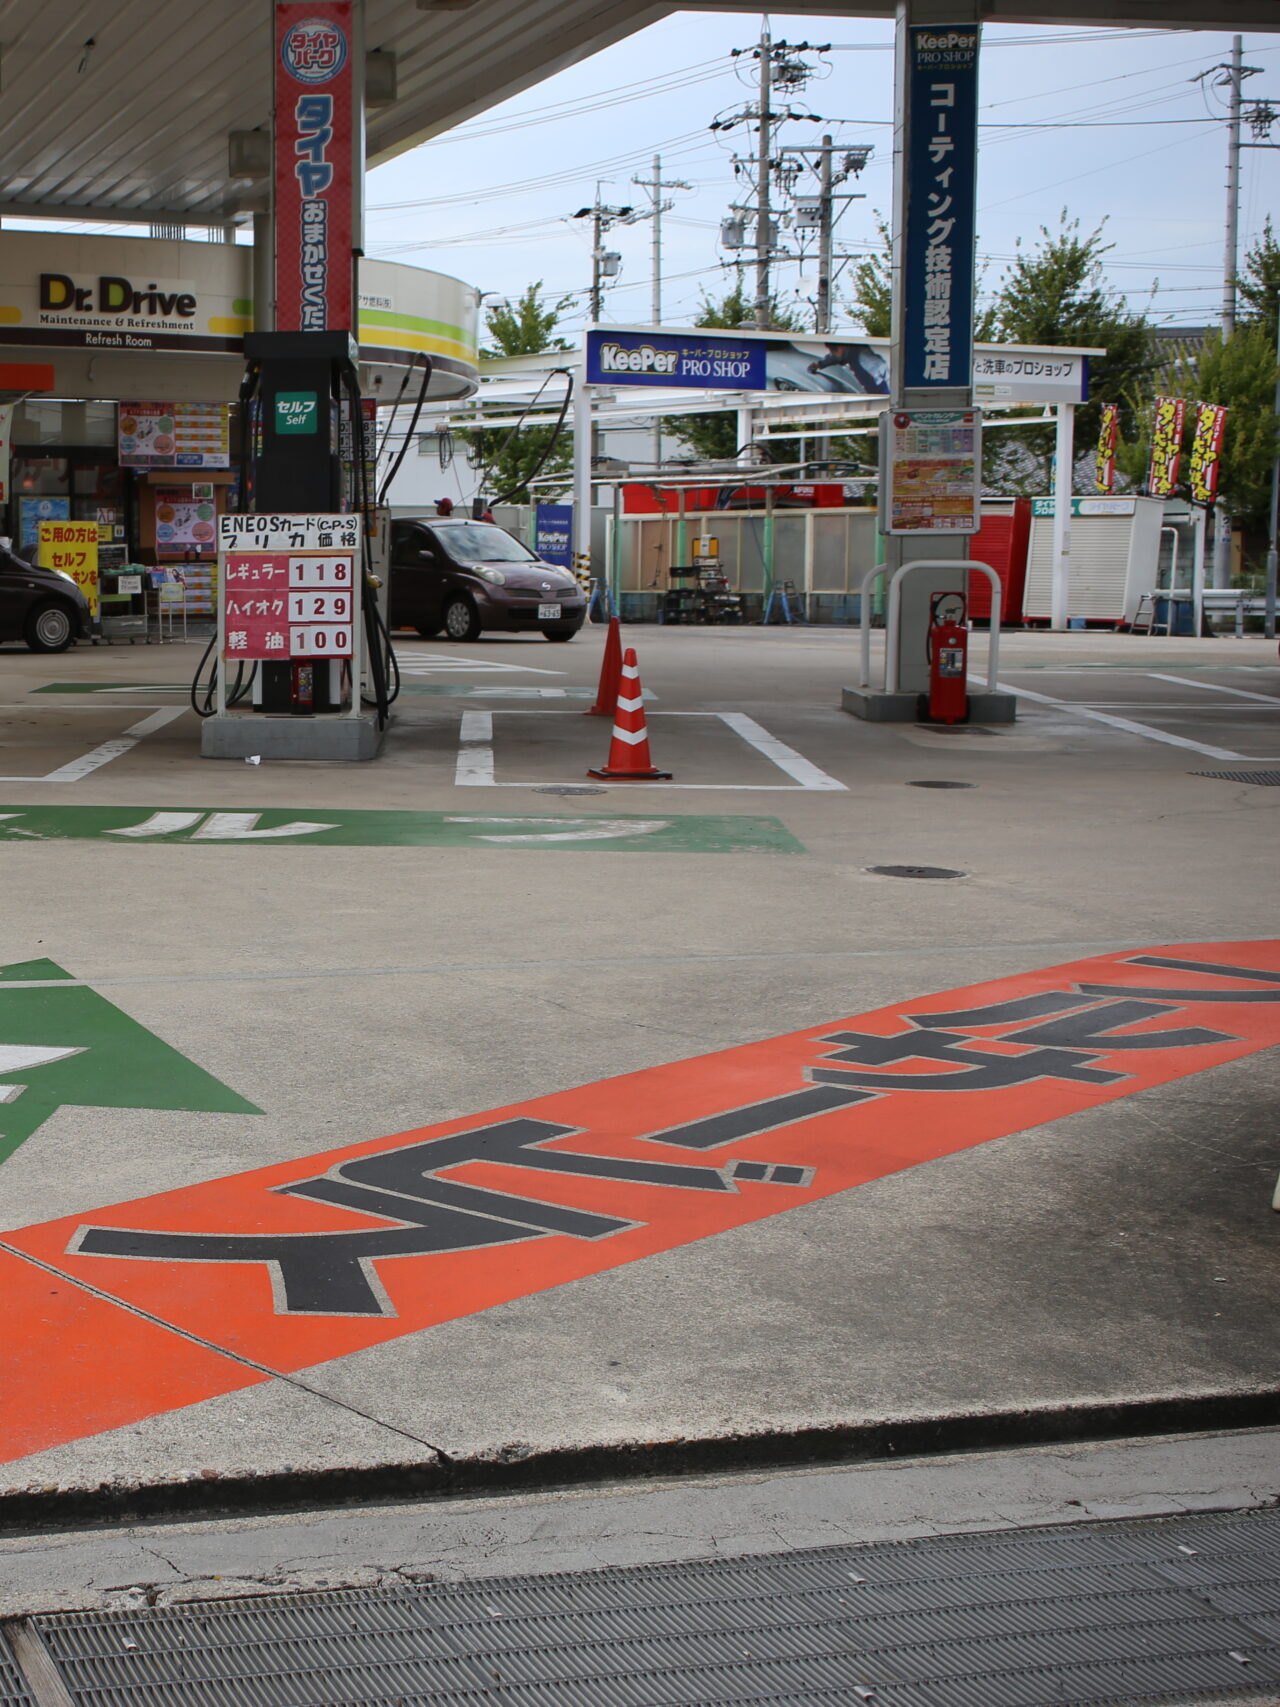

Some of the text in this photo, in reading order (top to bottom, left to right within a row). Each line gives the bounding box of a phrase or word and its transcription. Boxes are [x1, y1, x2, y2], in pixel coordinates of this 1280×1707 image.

[291, 32, 338, 49] タイヤ
[917, 33, 976, 49] KeePer
[294, 48, 334, 67] パーク
[917, 50, 974, 63] PRO SHOP
[923, 83, 956, 381] コーティング技術認定店
[39, 273, 197, 317] Dr. Drive
[40, 314, 195, 330] Maintenance & Refreshment
[86, 333, 153, 346] Refresh Room
[602, 344, 678, 374] KeePer
[682, 349, 750, 360] キーパープロショップ
[682, 359, 751, 378] PRO SHOP
[973, 358, 1073, 377] と洗車のプロショップ
[277, 401, 315, 413] セルフ
[286, 414, 307, 425] Self
[41, 527, 97, 543] ご用の方は
[538, 531, 569, 543] KeePer
[52, 552, 87, 567] セルフ
[226, 563, 285, 580] レギュラー
[295, 563, 347, 581] 118
[226, 599, 284, 616] ハイオク
[295, 598, 346, 615] 129
[228, 630, 284, 649] 軽油
[296, 632, 347, 649] 100
